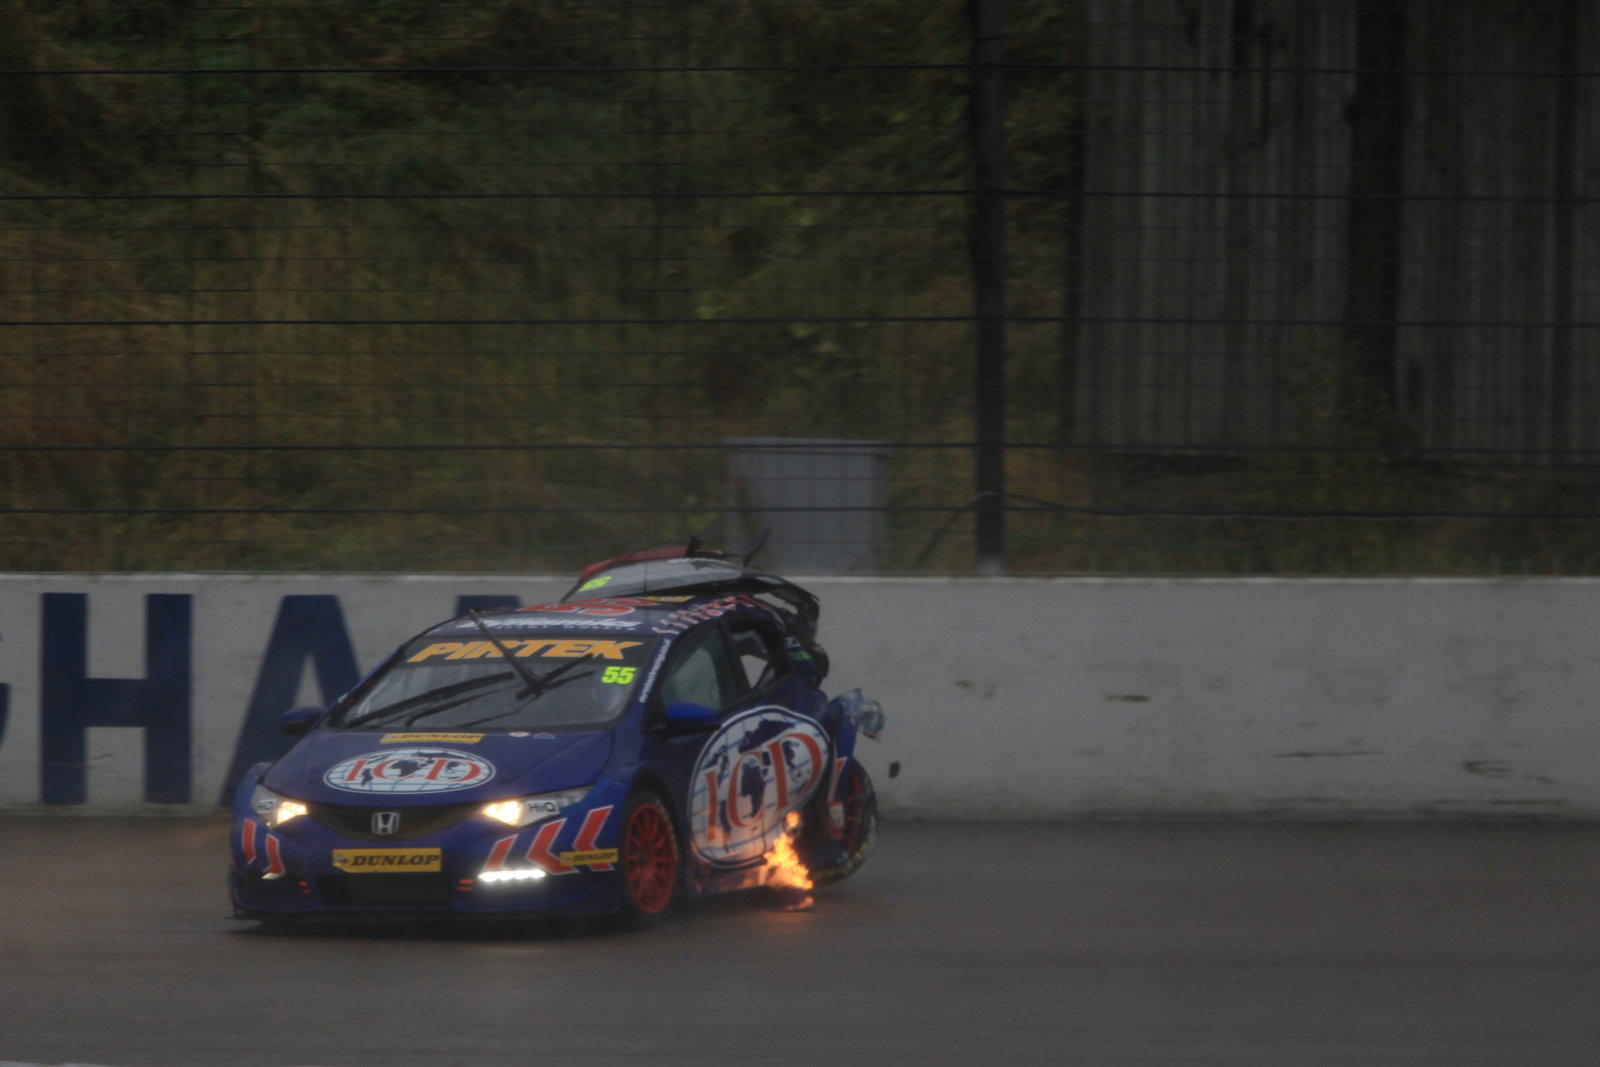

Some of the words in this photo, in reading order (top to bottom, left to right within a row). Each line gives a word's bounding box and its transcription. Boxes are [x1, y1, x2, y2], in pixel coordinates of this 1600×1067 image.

[406, 639, 644, 662] PIRTEK
[601, 666, 637, 685] 55
[343, 757, 482, 783] ICD
[703, 732, 823, 842] ICD
[351, 854, 439, 867] DUNLOP
